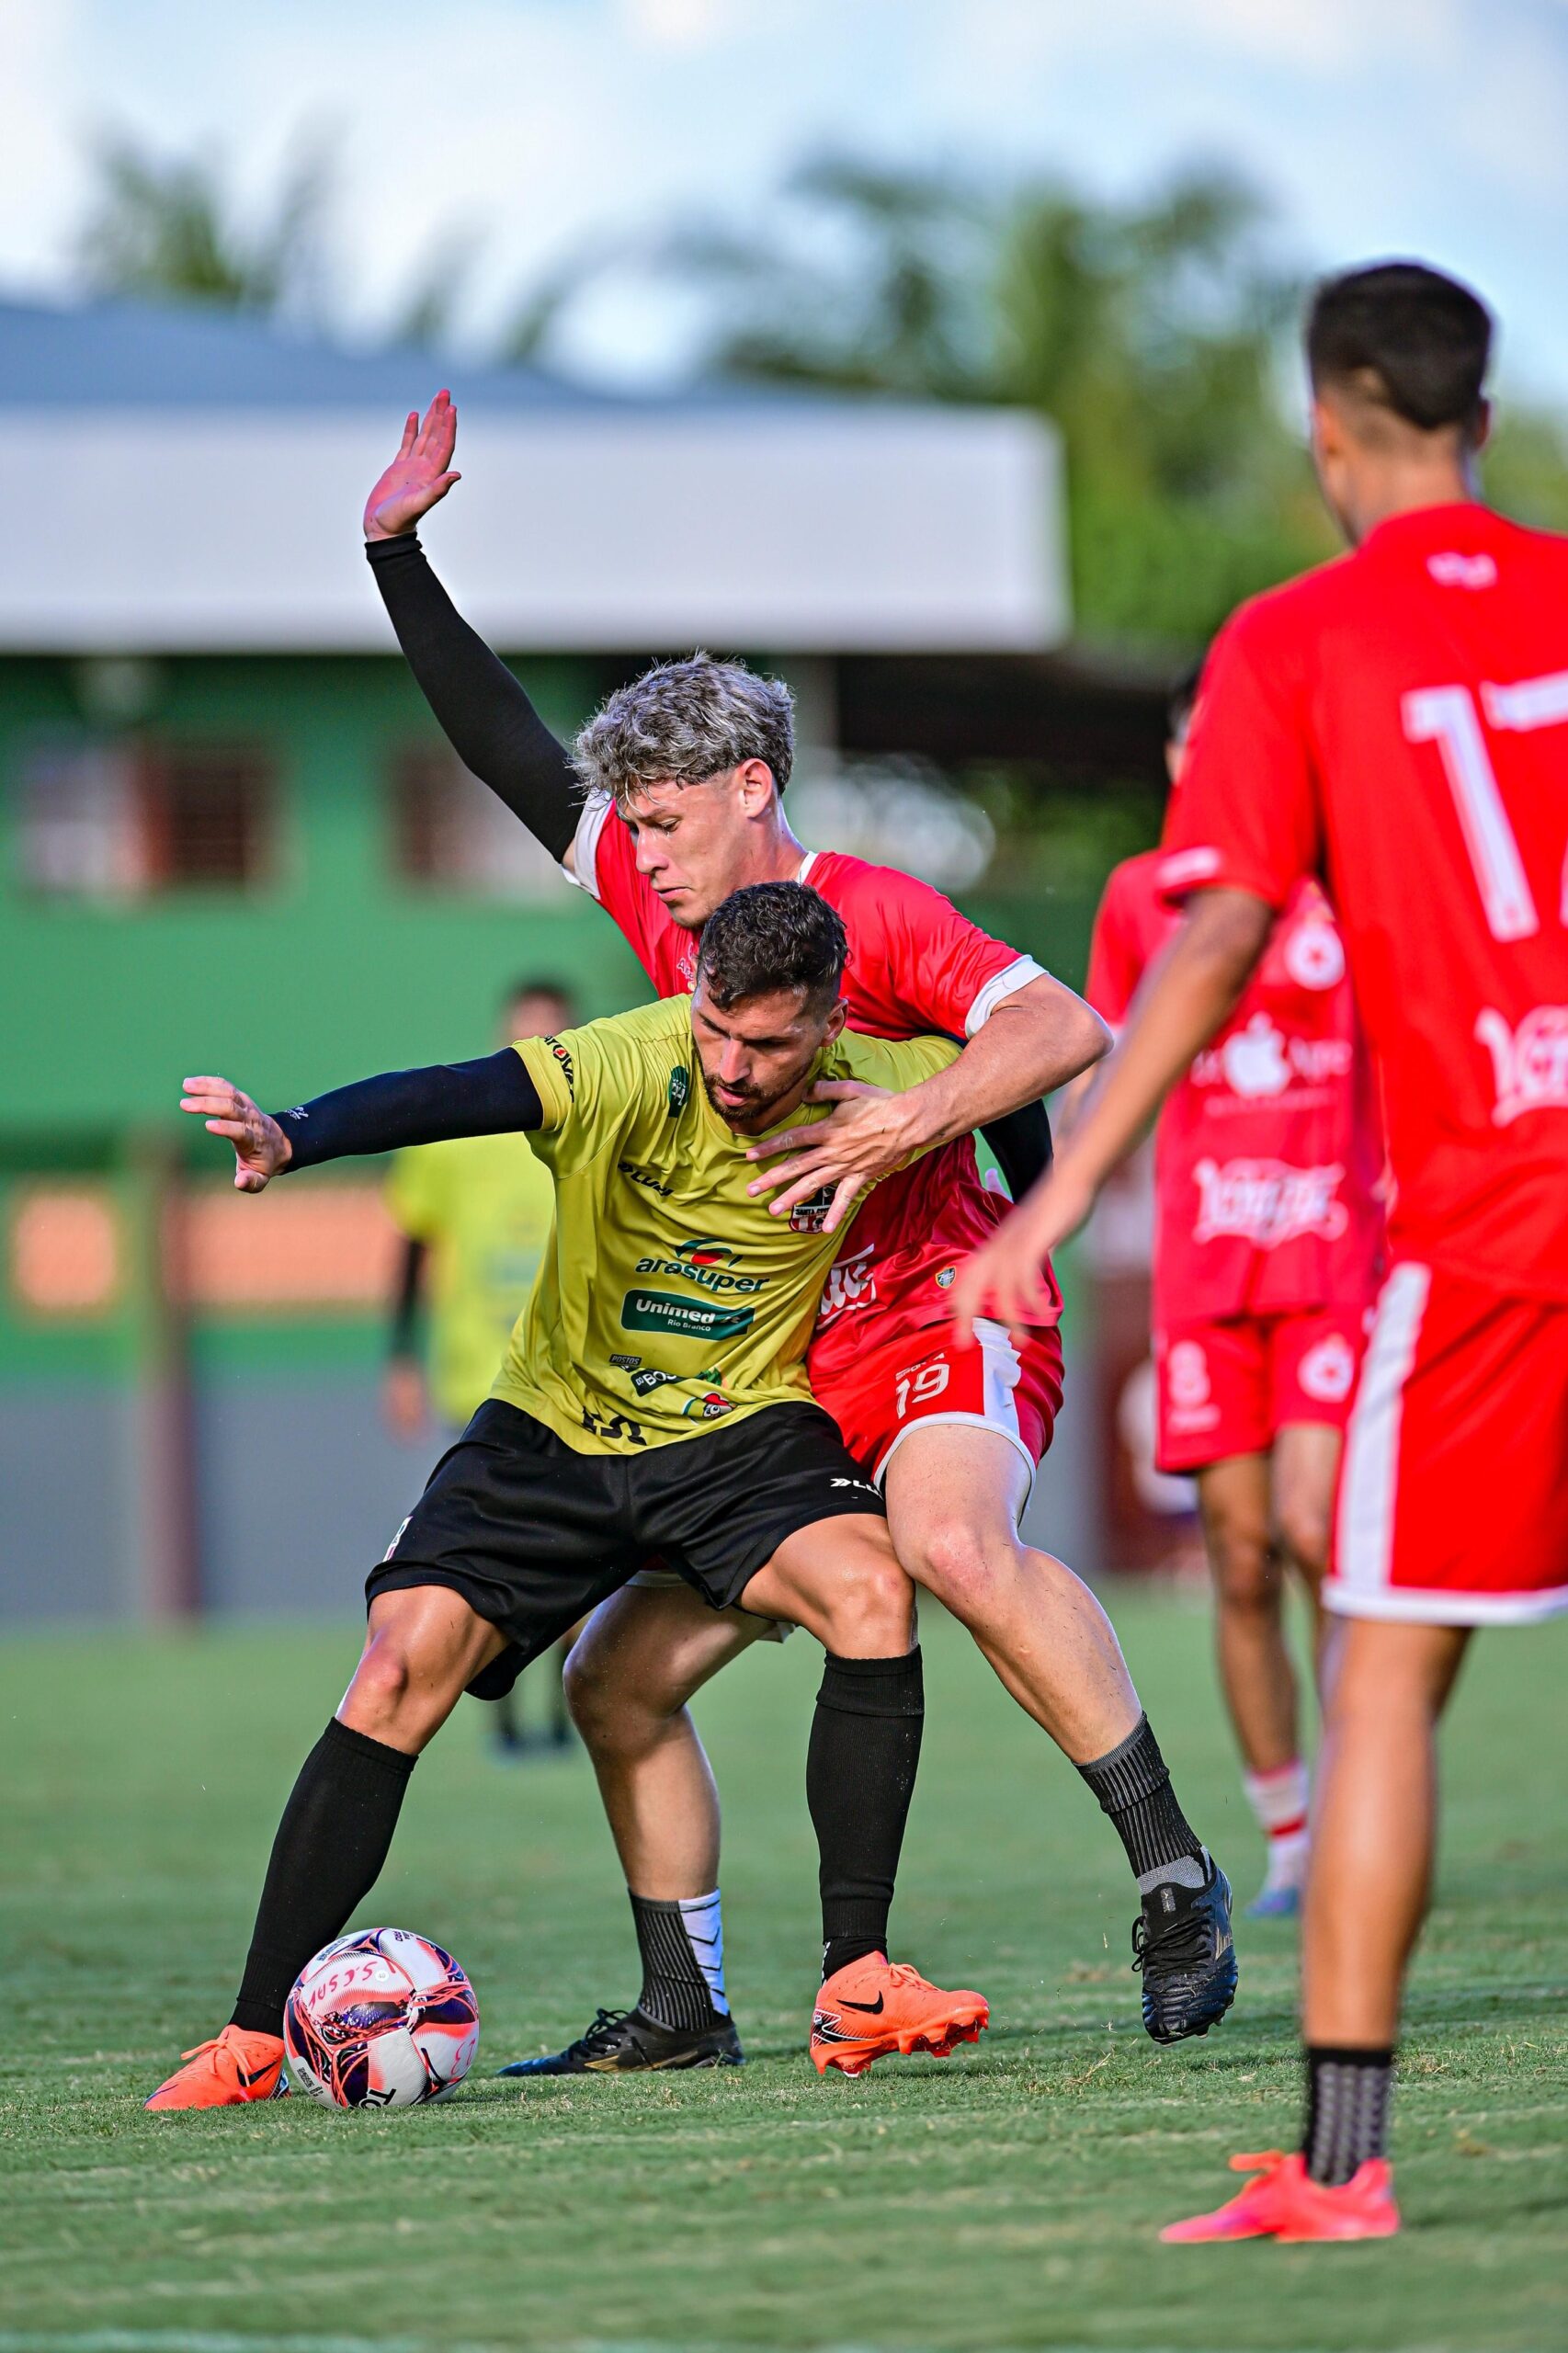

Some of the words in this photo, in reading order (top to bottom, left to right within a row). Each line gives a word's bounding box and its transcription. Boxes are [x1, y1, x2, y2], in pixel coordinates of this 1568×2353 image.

[635, 1256, 770, 1292] arasuper
[636, 1298, 716, 1324] Unimed
[667, 1319, 681, 1328] Rio
[682, 1322, 711, 1332] Branco
[611, 1355, 640, 1366] POSTOS
[896, 1363, 949, 1419] 19
